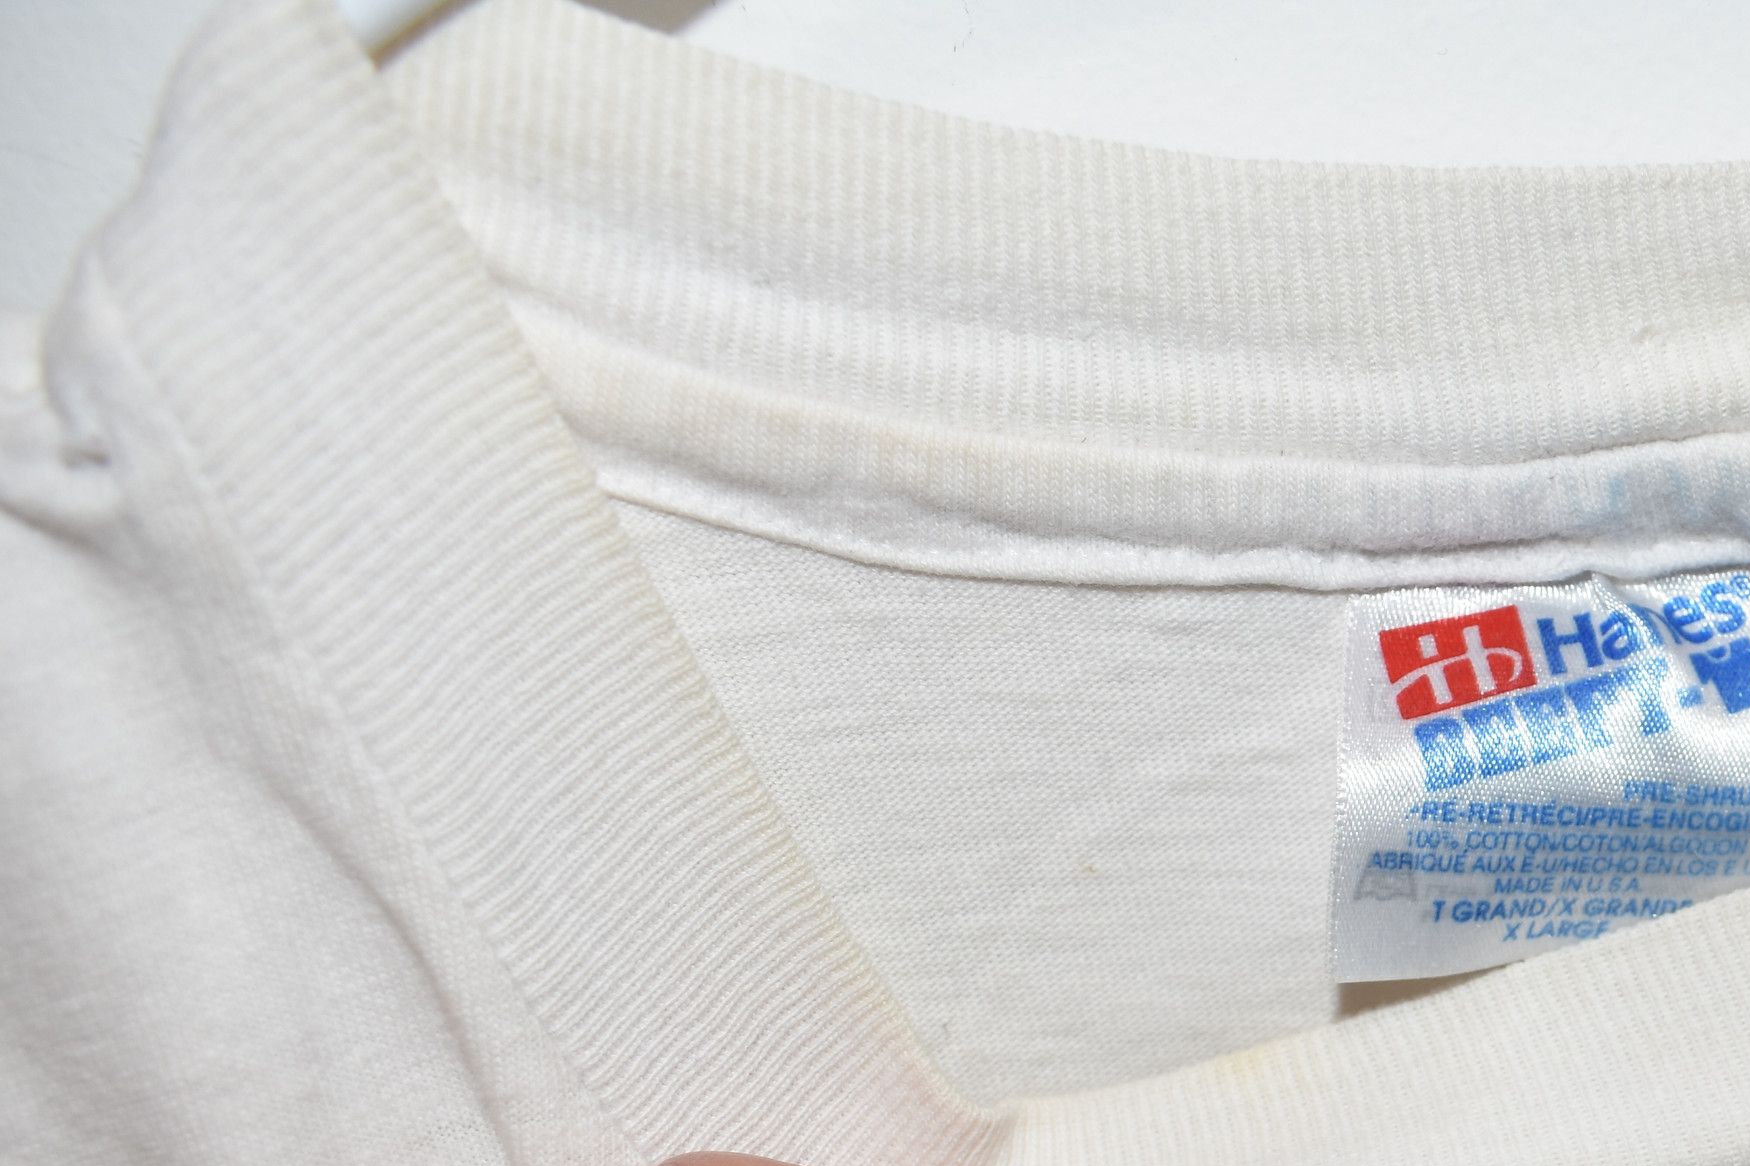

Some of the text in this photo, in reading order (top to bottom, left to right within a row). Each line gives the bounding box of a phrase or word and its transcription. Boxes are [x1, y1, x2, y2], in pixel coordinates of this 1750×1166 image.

[1471, 854, 1516, 874] AUX
[1644, 857, 1673, 874] EN
[1493, 877, 1553, 894] MADE
[1560, 877, 1582, 893] IN
[1432, 900, 1446, 923] T
[1502, 921, 1521, 943] X
